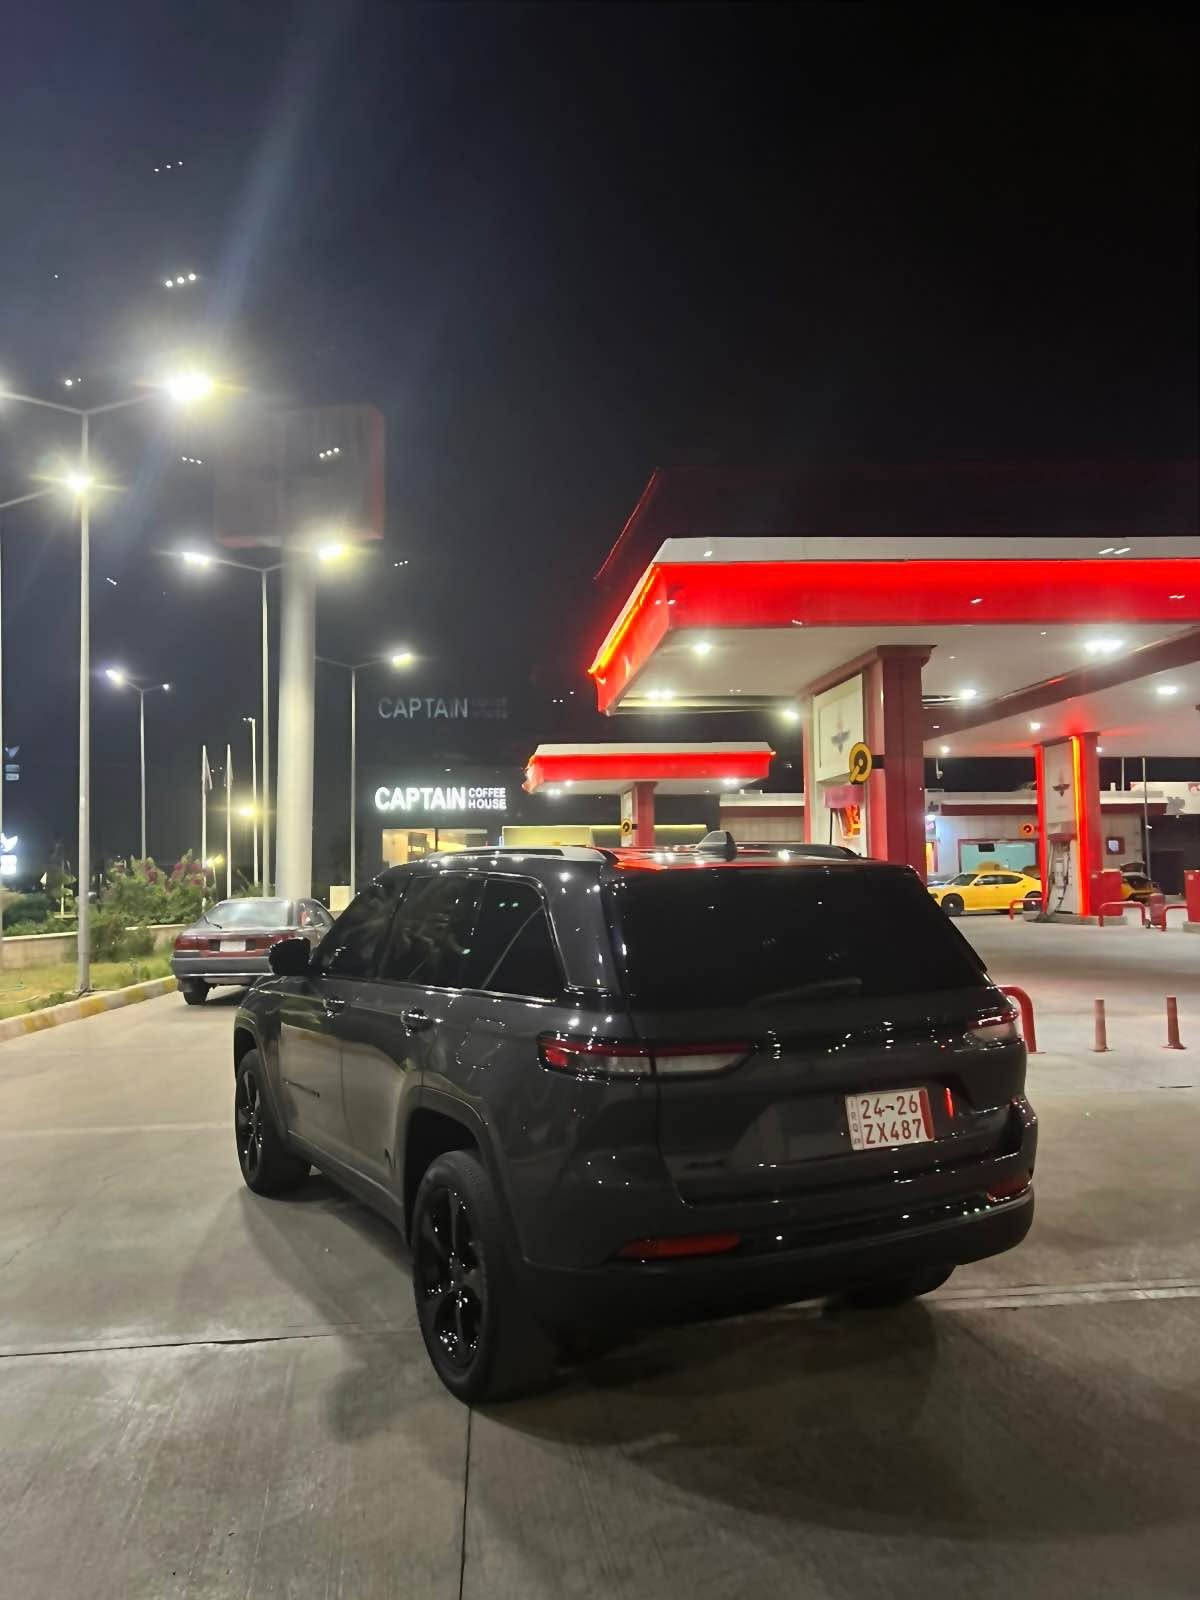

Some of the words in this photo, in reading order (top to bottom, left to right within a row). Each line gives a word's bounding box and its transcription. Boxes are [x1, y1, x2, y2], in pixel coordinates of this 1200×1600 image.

[378, 697, 468, 719] CAPTAIN
[374, 786, 466, 810] CAPTAIN
[468, 787, 507, 798] COFFEE
[468, 799, 507, 810] HOUSE
[861, 1094, 918, 1119] 24-26
[864, 1119, 922, 1144] ZX487
